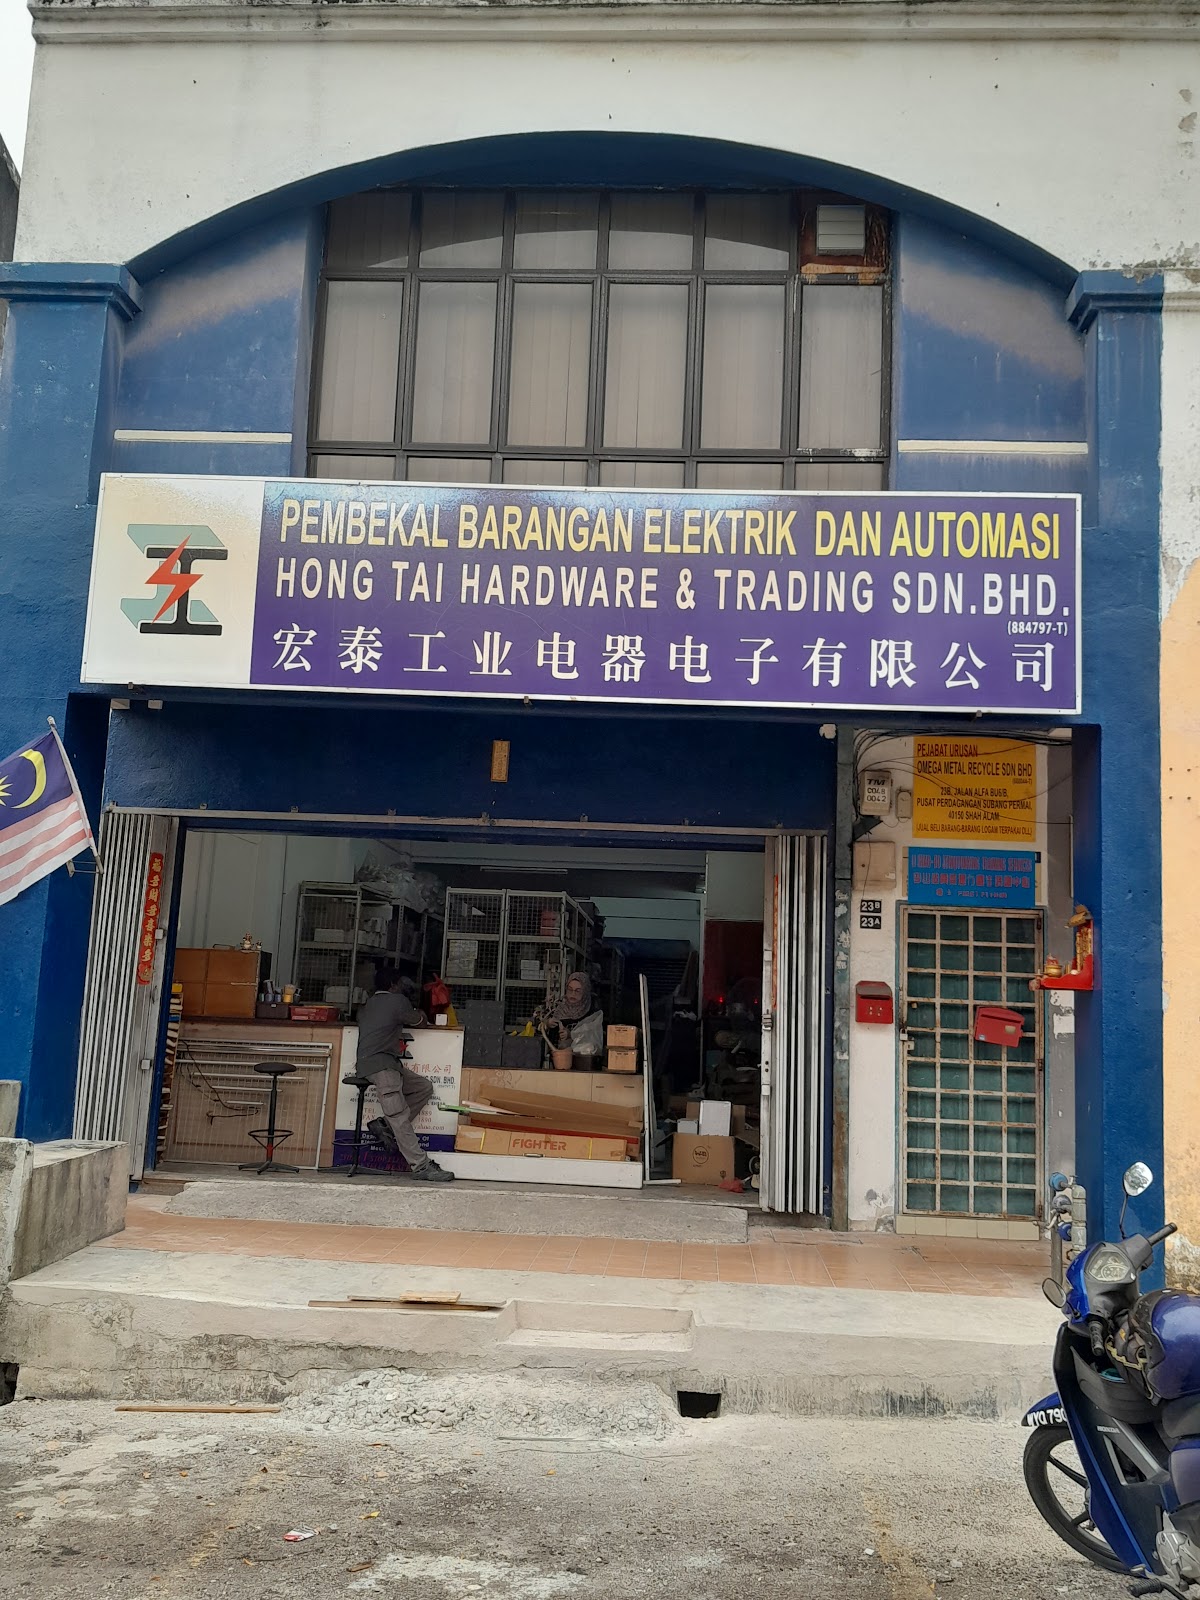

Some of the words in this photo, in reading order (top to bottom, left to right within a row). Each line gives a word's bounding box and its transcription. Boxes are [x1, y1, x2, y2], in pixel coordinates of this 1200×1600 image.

[280, 498, 450, 549] PEMBEKAL
[457, 503, 633, 554] BARANGAN
[643, 508, 798, 556] ELEKTRIK
[815, 510, 882, 557] DAN
[889, 511, 1061, 559] AUTOMASI
[275, 557, 374, 600] HONG
[391, 560, 444, 603] TAI
[460, 563, 659, 609] HARDWARE
[675, 567, 697, 610] &
[714, 569, 874, 613] TRADING
[1006, 620, 1068, 636] (884797-T)
[271, 623, 1055, 692] 宏泰工业电器电子有限公司
[917, 743, 948, 757] PEJABAT
[949, 744, 978, 758] URUSAN
[917, 760, 941, 775] OMEGA
[943, 761, 967, 775] METAL
[968, 762, 1000, 776] RECYCLE
[1001, 763, 1016, 777] SDN
[1017, 763, 1033, 777] BHD
[867, 778, 886, 786] TM
[916, 797, 936, 807] PUSAT
[936, 798, 981, 808] PERDAGANGAN
[982, 799, 1008, 809] SUBANG
[965, 810, 981, 820] SHAH
[861, 901, 881, 912] 23B
[861, 917, 880, 927] 23A
[512, 1138, 567, 1151] FIGHTER
